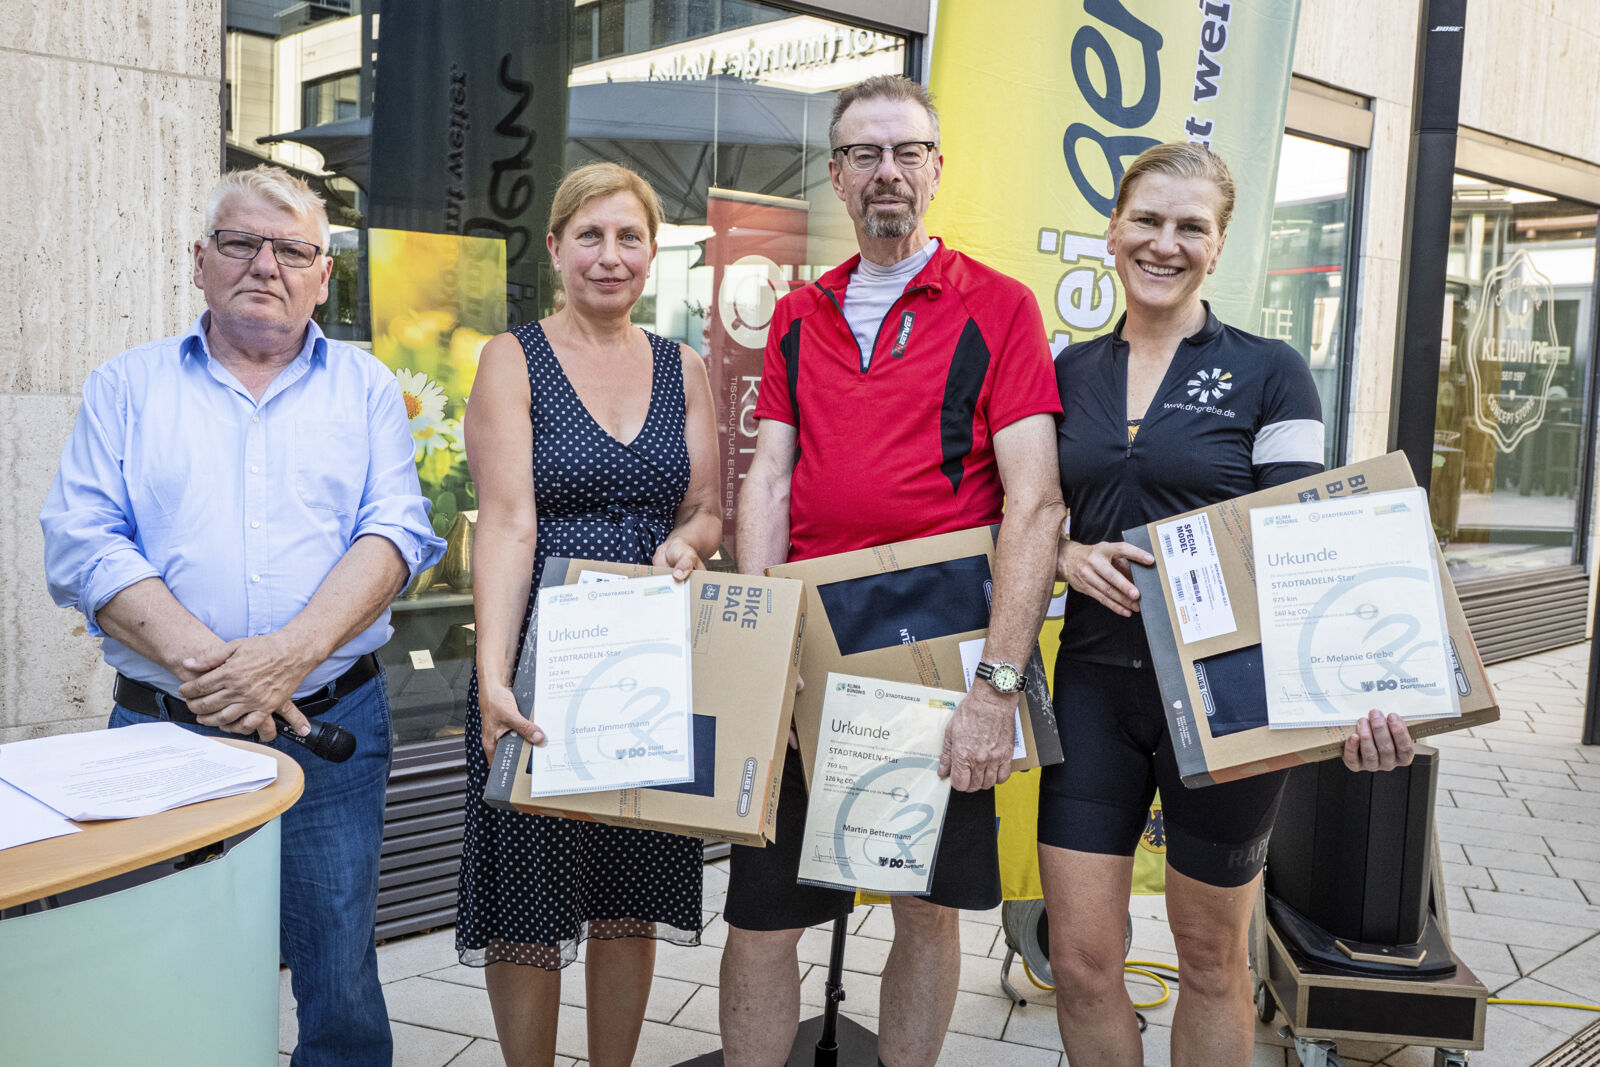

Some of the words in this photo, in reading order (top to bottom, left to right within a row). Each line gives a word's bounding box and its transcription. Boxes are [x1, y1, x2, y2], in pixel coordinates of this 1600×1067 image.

[1482, 337, 1549, 364] KLEIDHYPE
[727, 375, 738, 456] TISCHKULTUR
[1487, 393, 1515, 425] CONCEPT
[1514, 397, 1536, 424] STORE
[725, 458, 736, 521] ERLEBEN!
[1321, 509, 1363, 520] STADTRADELN
[1176, 526, 1188, 554] MODEL
[1184, 524, 1198, 557] SPECIAL
[1267, 547, 1337, 567] Urkunde
[1271, 574, 1356, 590] STADTRADELN-Star
[598, 590, 635, 598] STADTRADELN
[1273, 595, 1286, 603] 975
[1287, 594, 1298, 602] km
[722, 584, 743, 623] BAG
[741, 586, 763, 630] BIKE
[1288, 609, 1297, 618] kg
[548, 624, 609, 643] Urkunde
[548, 650, 622, 664] STADTRADELN-Star
[1310, 655, 1324, 664] Dr.
[1326, 651, 1364, 664] Melanie
[1365, 649, 1394, 659] Grebe
[846, 688, 866, 696] BÜNDNIS
[1377, 679, 1398, 691] DO
[1400, 681, 1437, 690] Dortmund
[885, 692, 921, 703] STADTRADELN
[571, 723, 597, 735] Stefan
[597, 719, 650, 732] Zimmermann
[831, 718, 890, 740] Urkunde
[628, 746, 646, 759] DO
[648, 748, 678, 757] Dortmund
[828, 746, 899, 765] STADTRADELN-Star
[827, 761, 837, 769] 769
[838, 763, 848, 771] km
[743, 759, 755, 790] ORTLIEB
[836, 776, 845, 785] kg
[842, 823, 868, 835] Martin
[869, 827, 912, 841] Bettermann
[889, 858, 904, 869] DO
